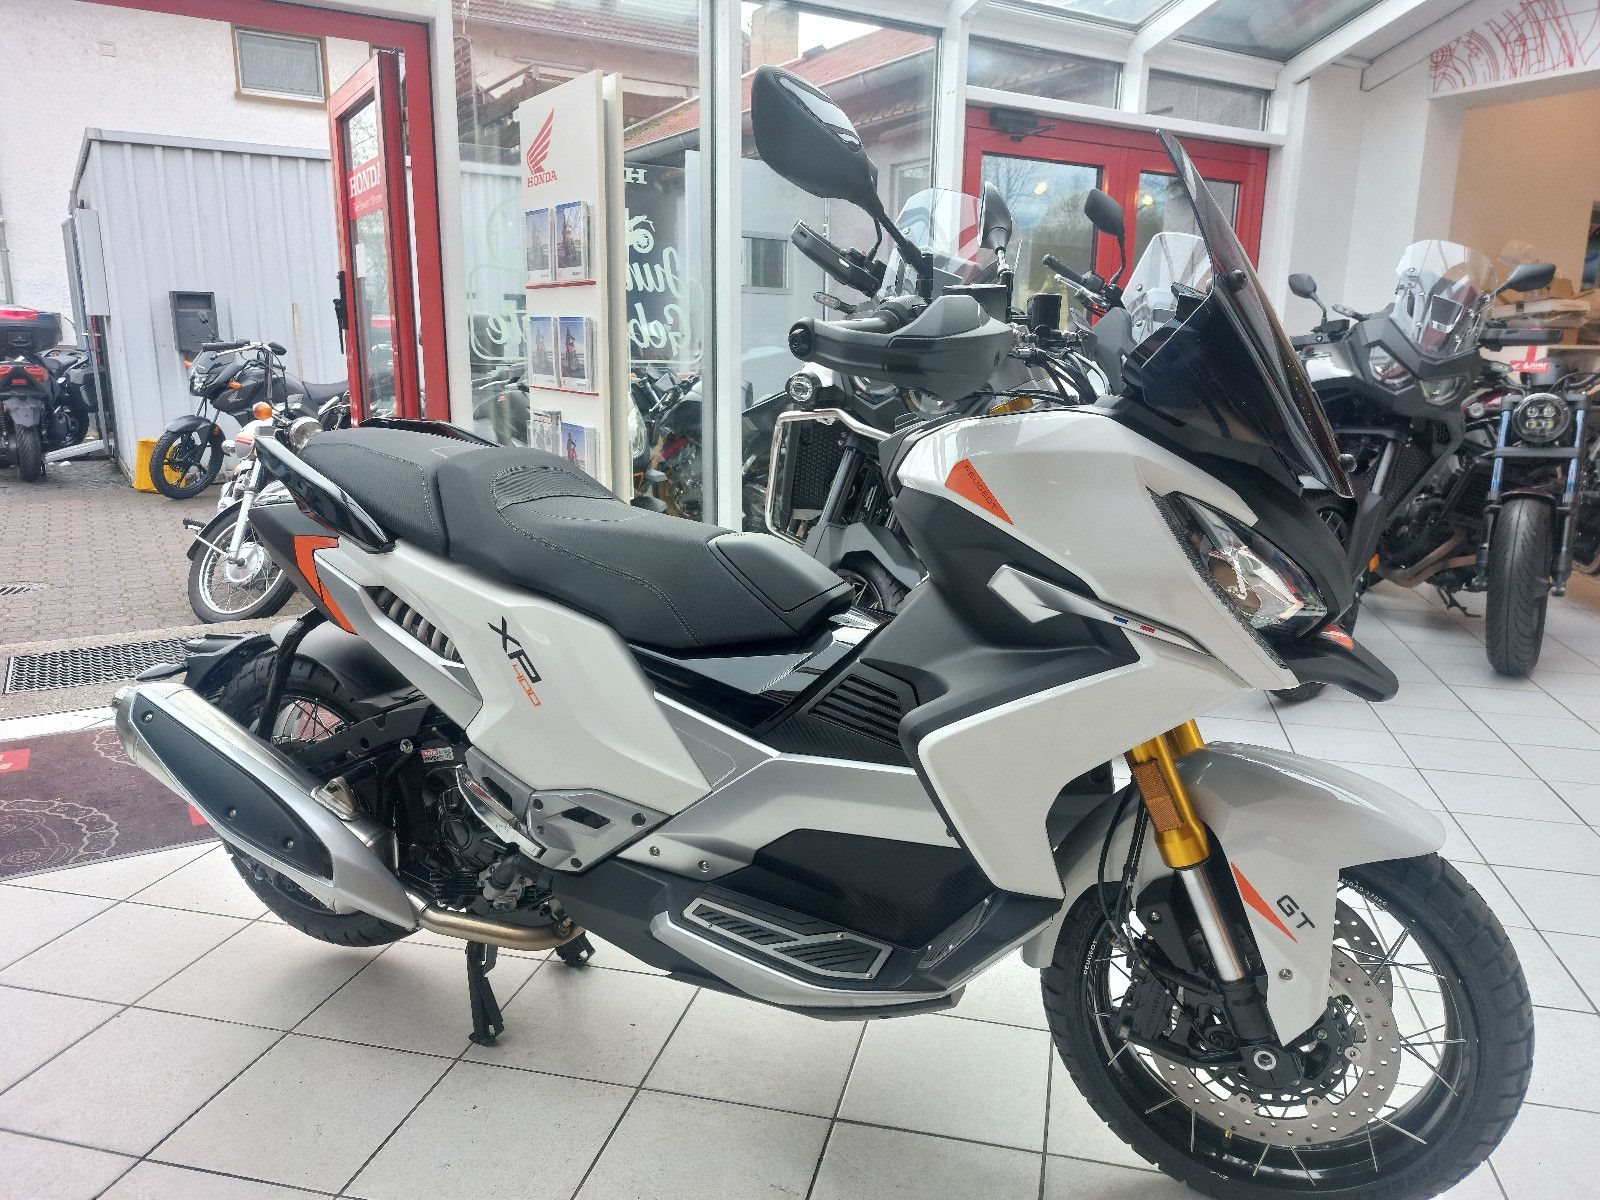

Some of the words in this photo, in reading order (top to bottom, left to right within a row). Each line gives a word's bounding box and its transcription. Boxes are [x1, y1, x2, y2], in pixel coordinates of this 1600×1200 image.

[527, 171, 557, 187] HONDA
[964, 465, 998, 509] PEUGEOT
[487, 616, 542, 684] XP
[512, 664, 542, 706] 400
[1276, 894, 1316, 929] GT
[1083, 939, 1098, 975] PEUGEOT
